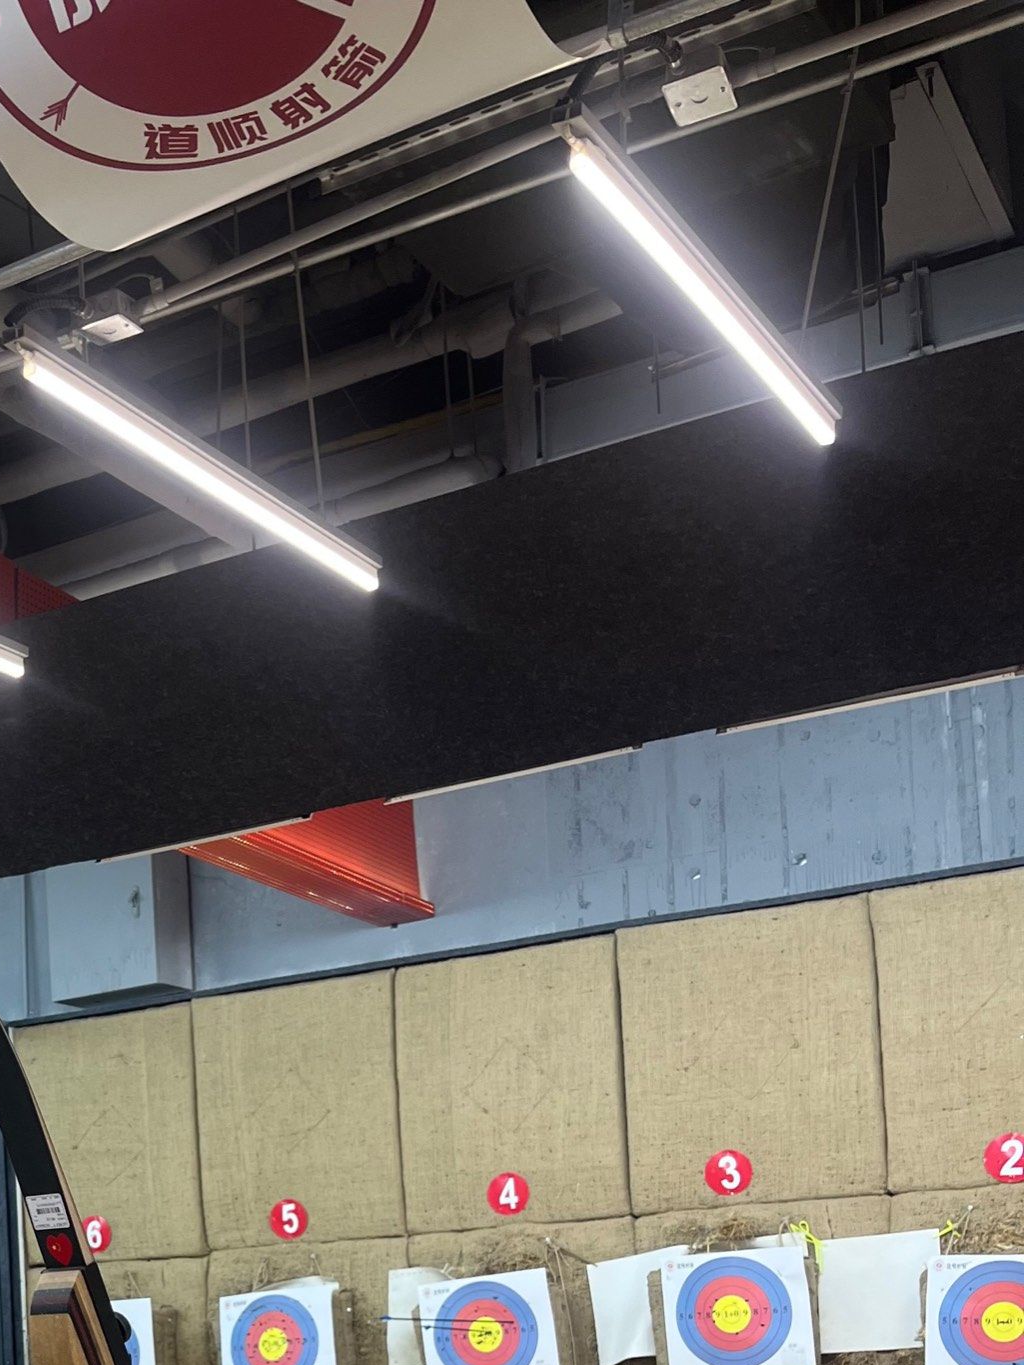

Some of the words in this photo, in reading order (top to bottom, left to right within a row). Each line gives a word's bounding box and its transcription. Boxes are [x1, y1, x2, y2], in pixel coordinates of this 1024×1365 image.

[144, 34, 387, 161] 道顺射箭
[719, 1155, 742, 1190] 3
[999, 1138, 1024, 1177] 2
[498, 1177, 520, 1209] 4
[86, 1219, 103, 1249] 6
[281, 1204, 300, 1234] 5
